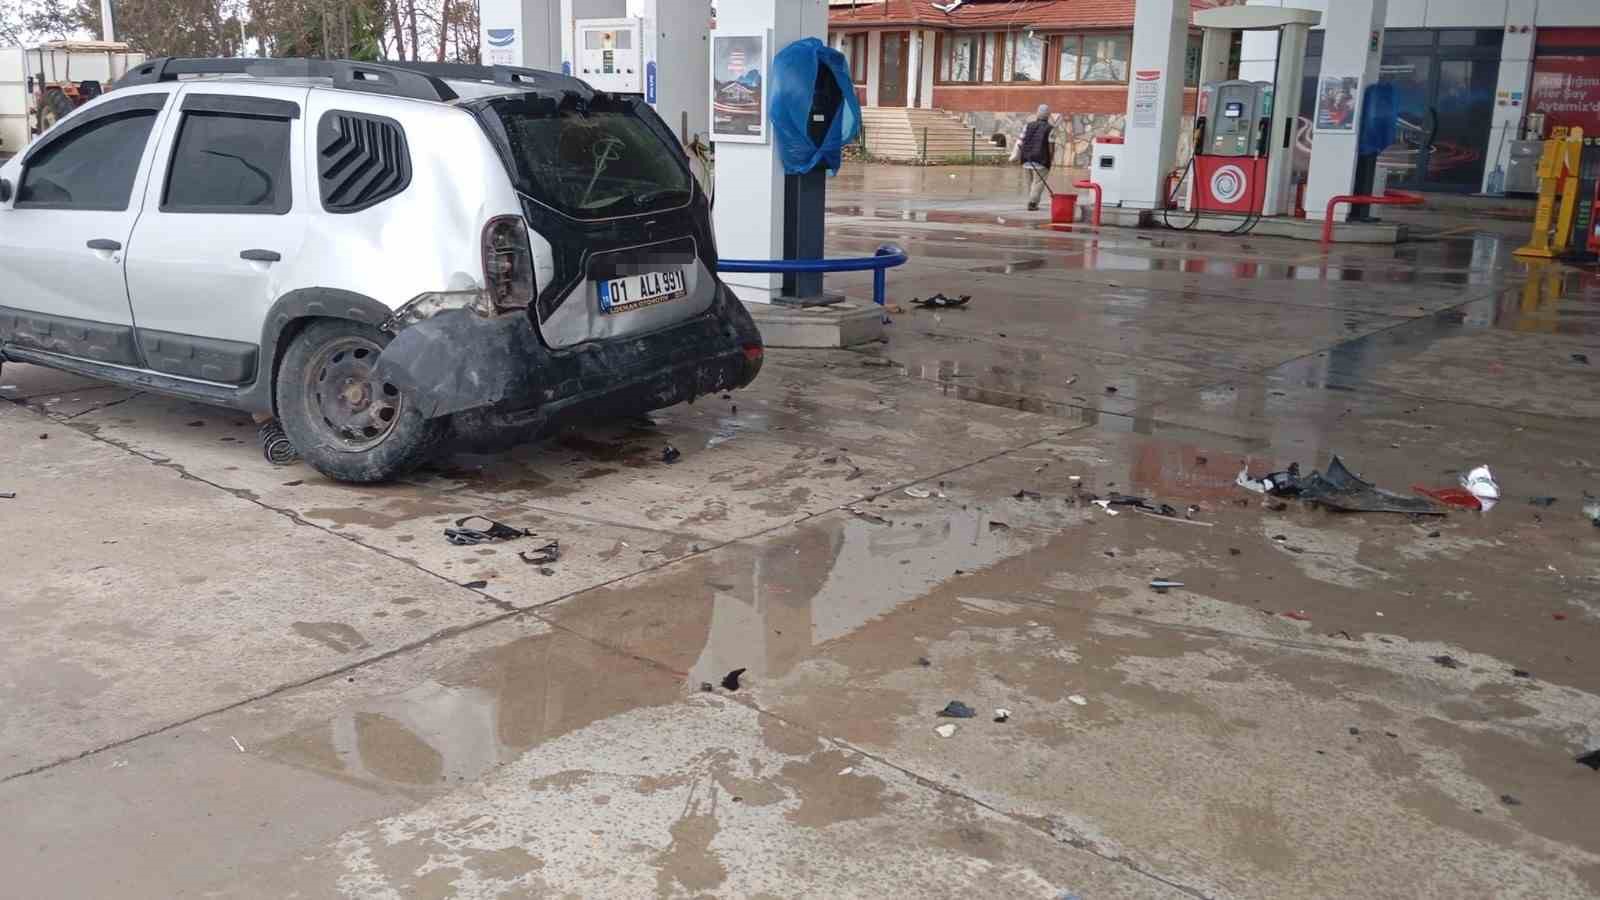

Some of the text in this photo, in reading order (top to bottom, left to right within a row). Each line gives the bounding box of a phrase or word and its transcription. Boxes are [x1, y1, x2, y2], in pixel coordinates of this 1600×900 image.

[610, 270, 682, 303] 01 ALA 991
